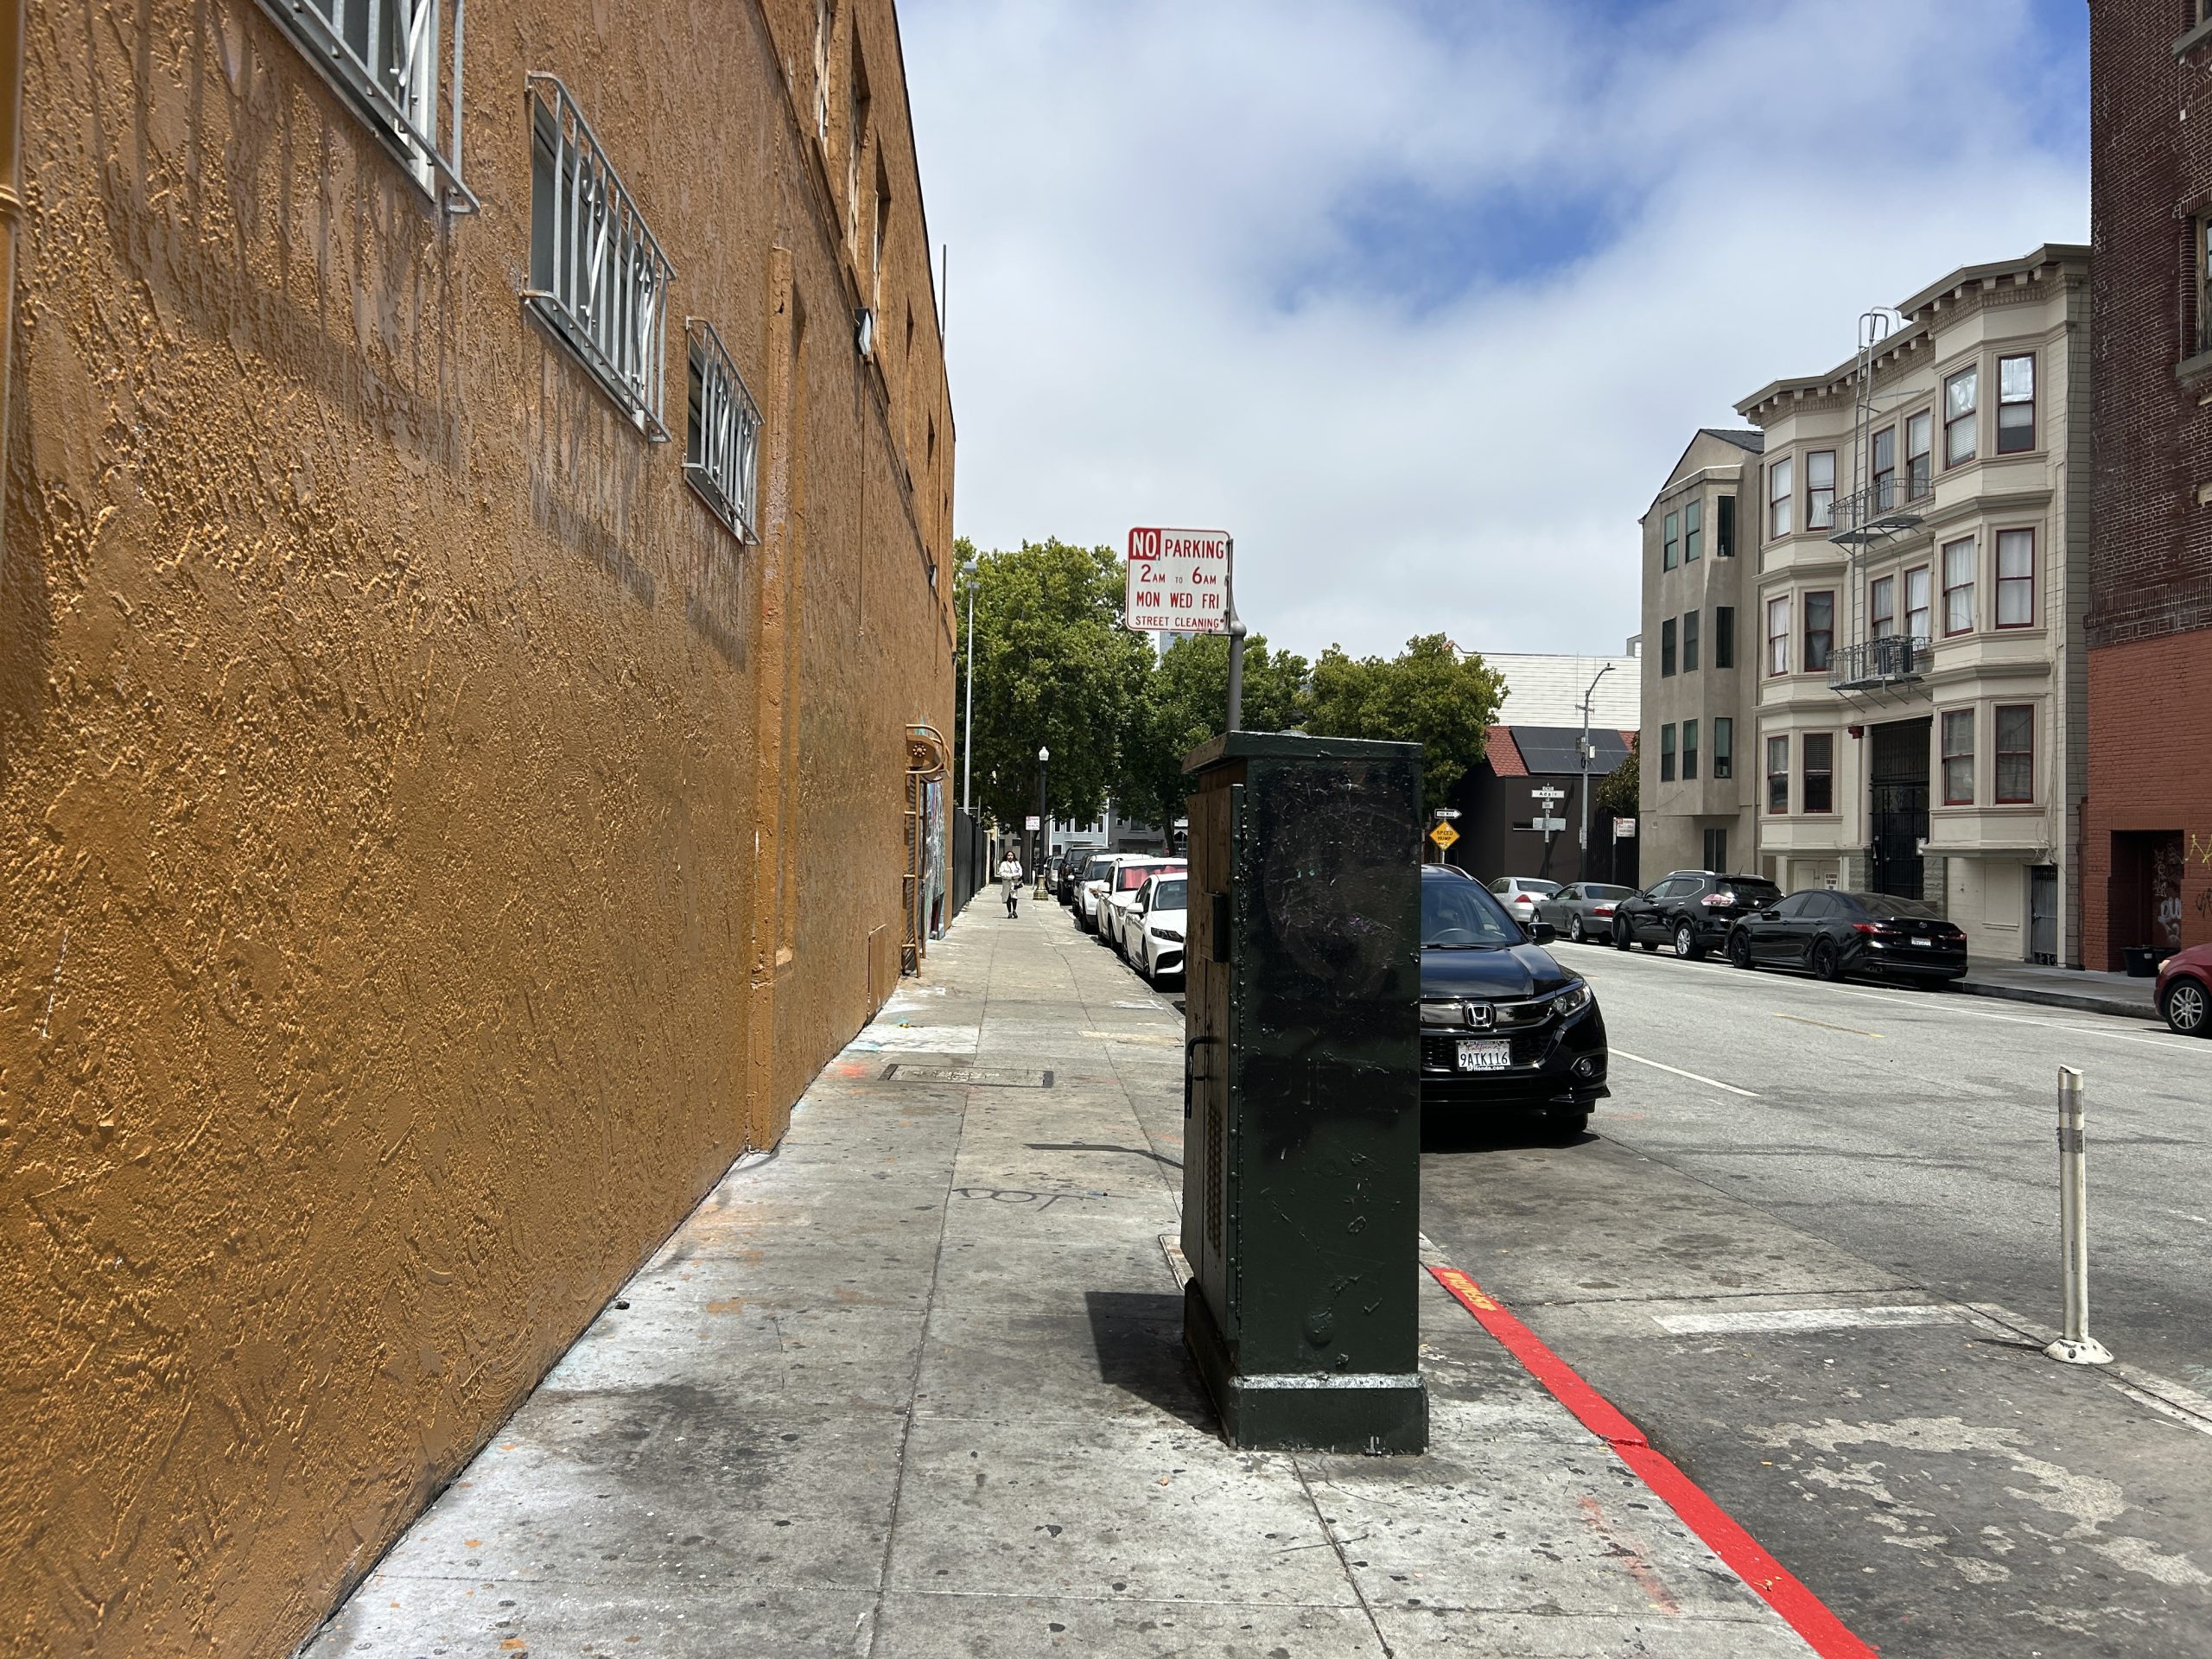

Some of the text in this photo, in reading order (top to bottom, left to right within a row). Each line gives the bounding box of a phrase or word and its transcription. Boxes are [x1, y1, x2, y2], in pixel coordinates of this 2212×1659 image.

[1132, 531, 1224, 560] NO PARKING
[1140, 563, 1166, 583] 2AM
[1192, 566, 1217, 585] 6AM
[1136, 591, 1219, 609] MON WED FRI
[1135, 615, 1219, 628] STREET CLEANING
[1460, 1052, 1508, 1066] 9AIK116
